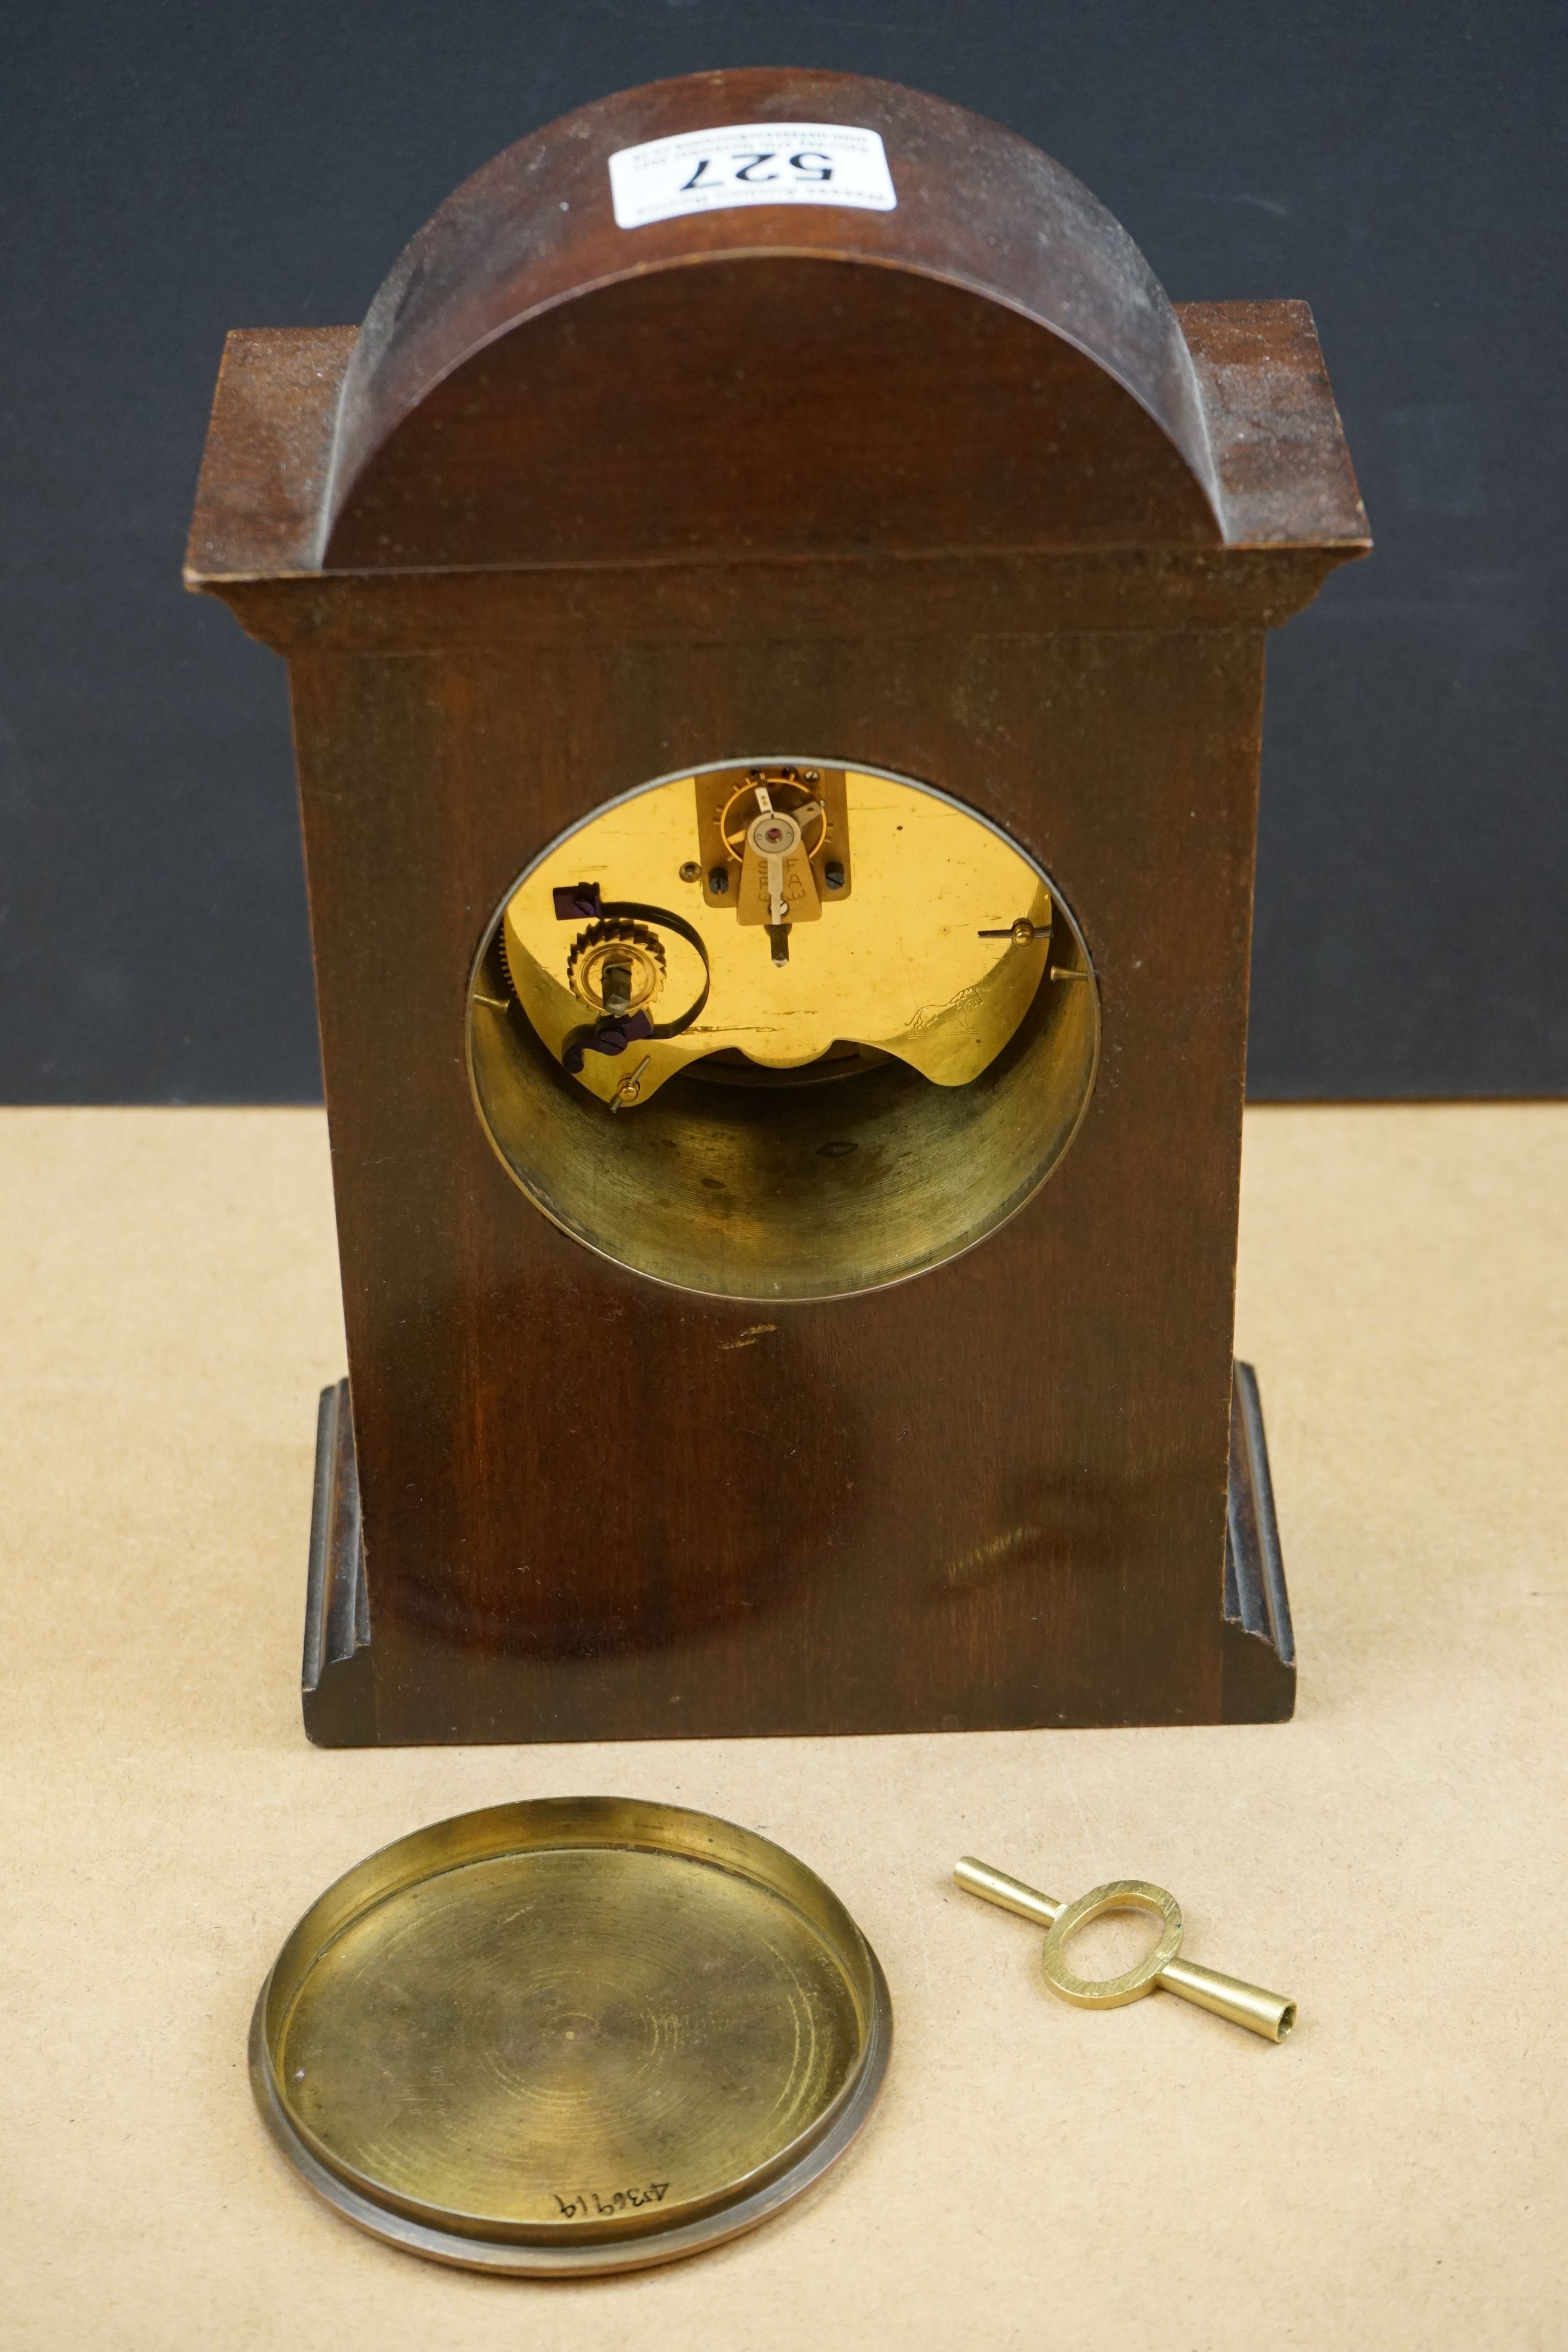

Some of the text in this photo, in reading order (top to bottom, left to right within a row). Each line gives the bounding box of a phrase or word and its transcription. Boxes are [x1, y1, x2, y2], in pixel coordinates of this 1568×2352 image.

[680, 152, 834, 191] 527
[786, 858, 799, 872] F
[788, 874, 803, 888] A
